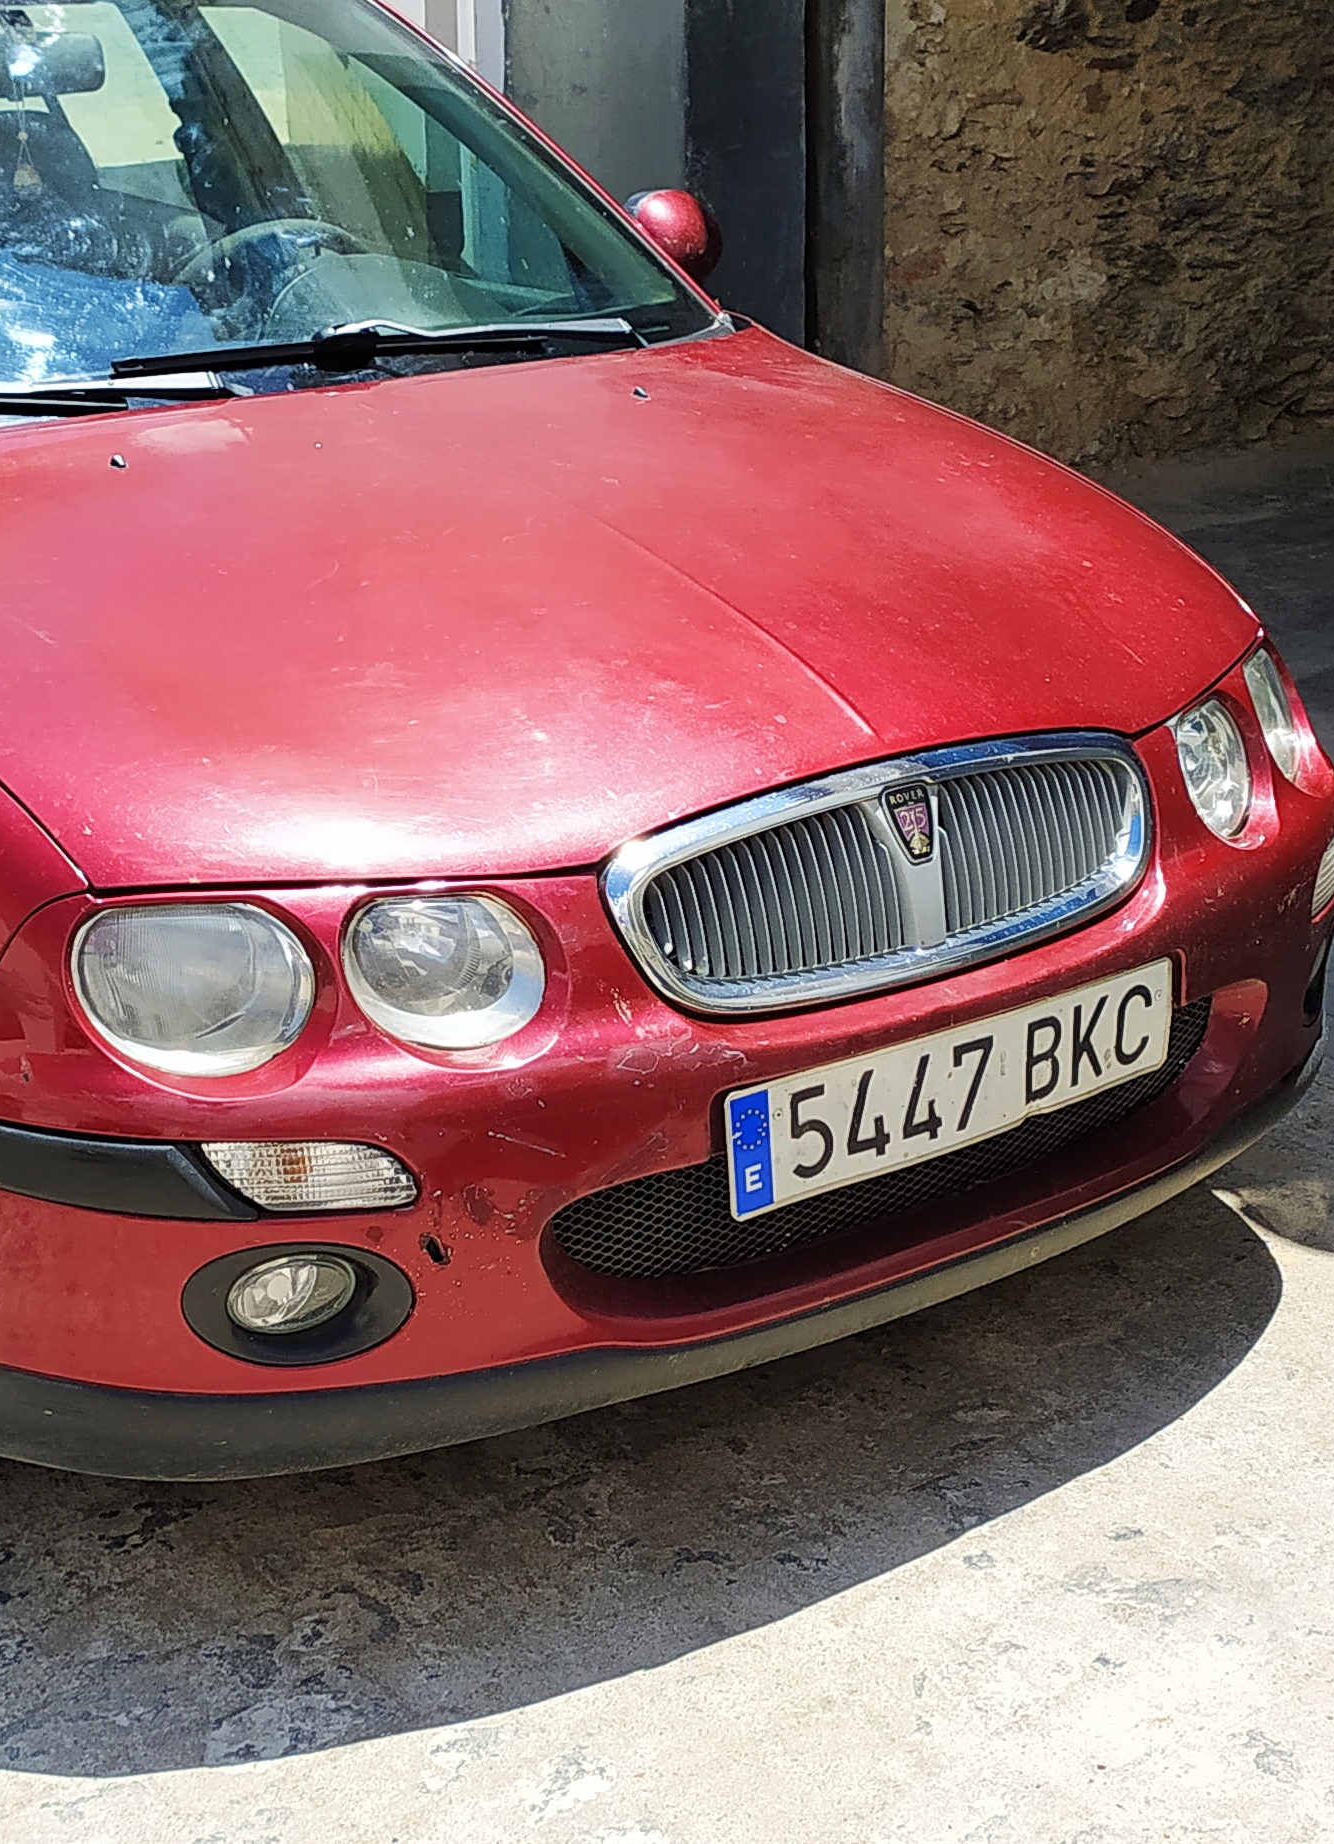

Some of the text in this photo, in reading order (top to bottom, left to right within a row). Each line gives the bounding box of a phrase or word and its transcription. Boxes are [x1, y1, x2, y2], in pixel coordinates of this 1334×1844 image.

[889, 788, 925, 805] ROVER
[789, 984, 1153, 1178] 5447 BKC
[744, 1165, 762, 1192] E
